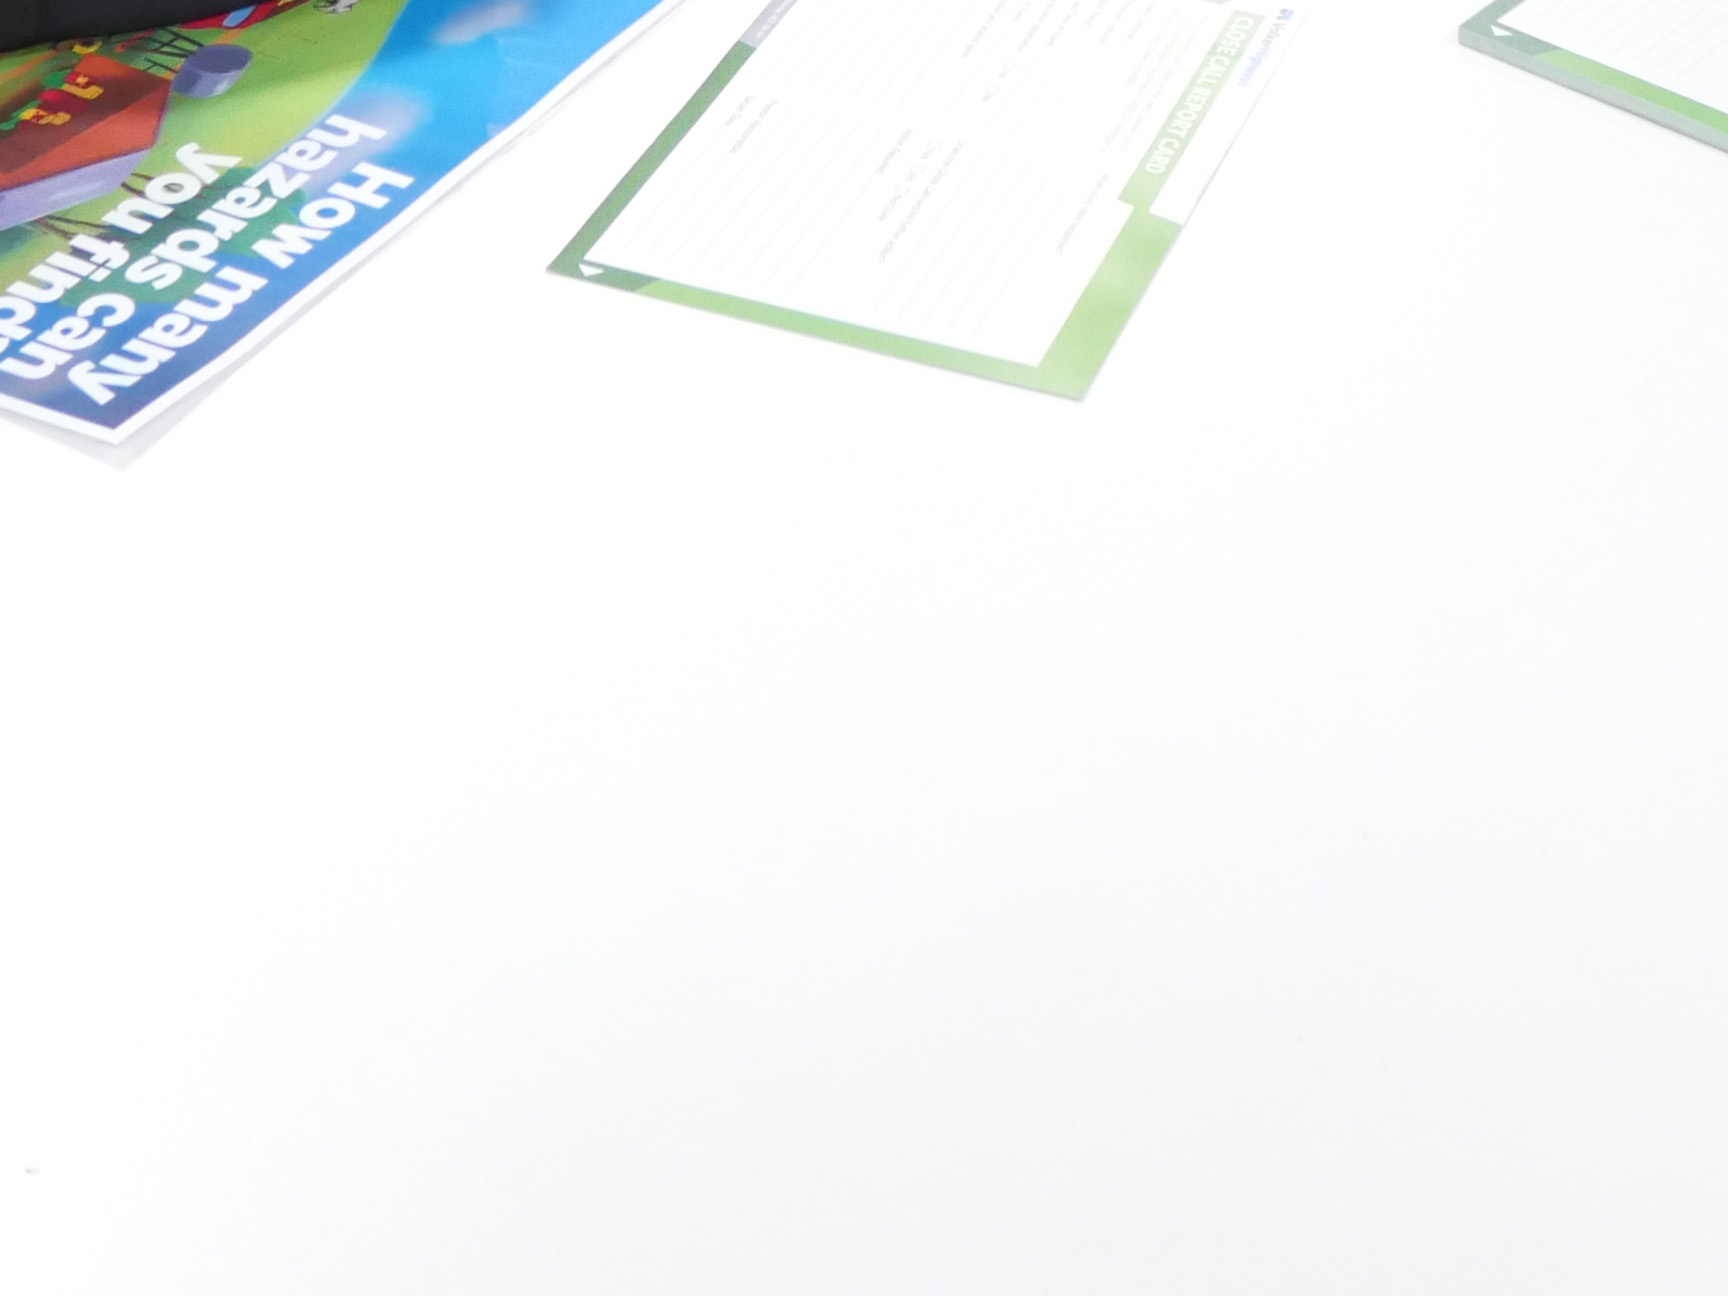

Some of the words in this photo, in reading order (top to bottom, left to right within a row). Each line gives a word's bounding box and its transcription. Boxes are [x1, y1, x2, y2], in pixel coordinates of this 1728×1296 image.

[1212, 14, 1256, 57] CLOSE
[1234, 19, 1288, 89] VolkerHighways
[1193, 53, 1233, 89] CALL
[1163, 84, 1213, 139] REPORT
[101, 141, 243, 236] you
[1140, 135, 1182, 176] CARD
[123, 114, 388, 291] hazards
[251, 161, 415, 270] How
[66, 265, 269, 406] many
